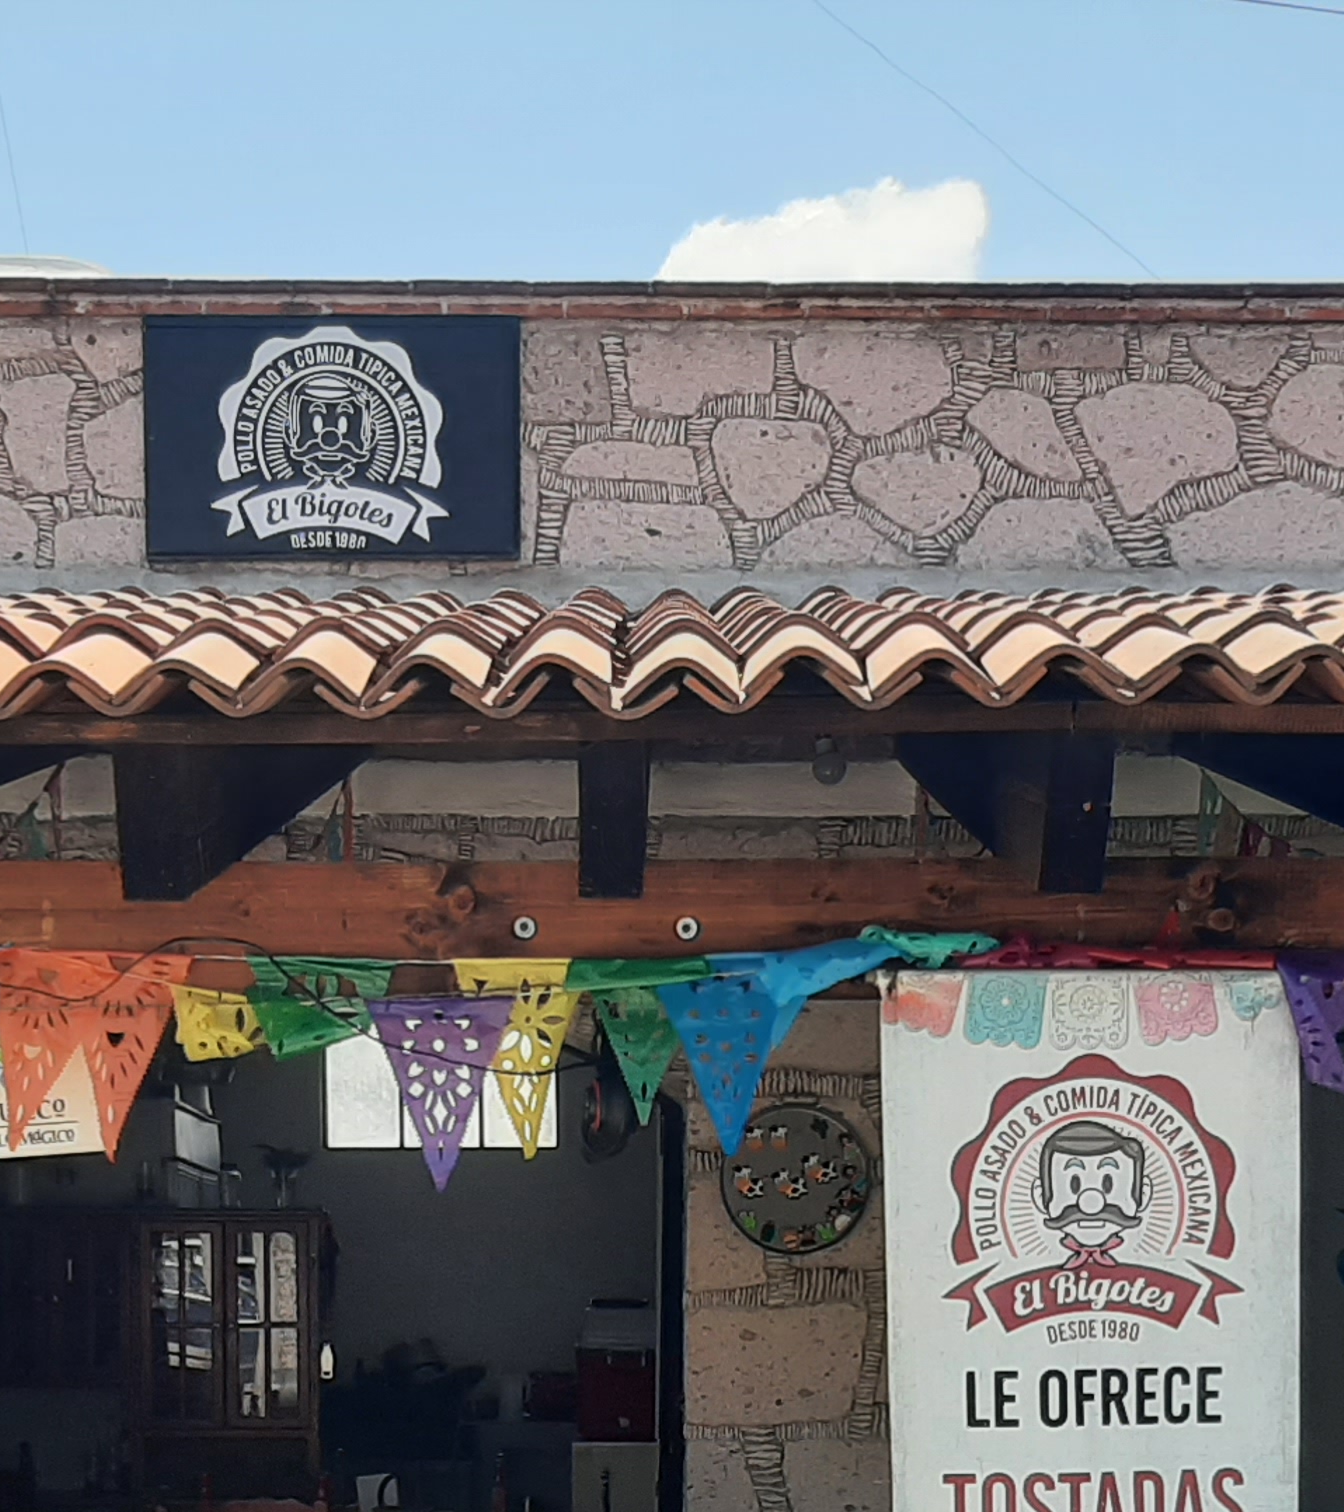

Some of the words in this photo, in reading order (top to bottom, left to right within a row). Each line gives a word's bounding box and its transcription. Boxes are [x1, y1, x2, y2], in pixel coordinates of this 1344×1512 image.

[277, 359, 294, 378] &
[293, 345, 355, 369] COMIDA
[241, 369, 282, 419] ASADO
[236, 421, 257, 474] POLLO
[394, 392, 424, 479] MEXICANA
[265, 497, 290, 526] El
[293, 491, 394, 529] Bigotes
[290, 530, 333, 549] DESDE
[334, 530, 367, 550] 1980
[1023, 1105, 1045, 1127] &
[1043, 1085, 1121, 1117] COMIDA
[978, 1118, 1027, 1184] ASADO
[1172, 1140, 1213, 1246] MEXICANA
[973, 1186, 1003, 1251] POLLO
[1013, 1278, 1045, 1317] El
[1048, 1270, 1176, 1313] Bigotes
[1046, 1319, 1098, 1345] DESDE
[1101, 1319, 1141, 1342] 1980
[965, 1370, 1020, 1429] LE
[1039, 1366, 1224, 1428] OFRECE
